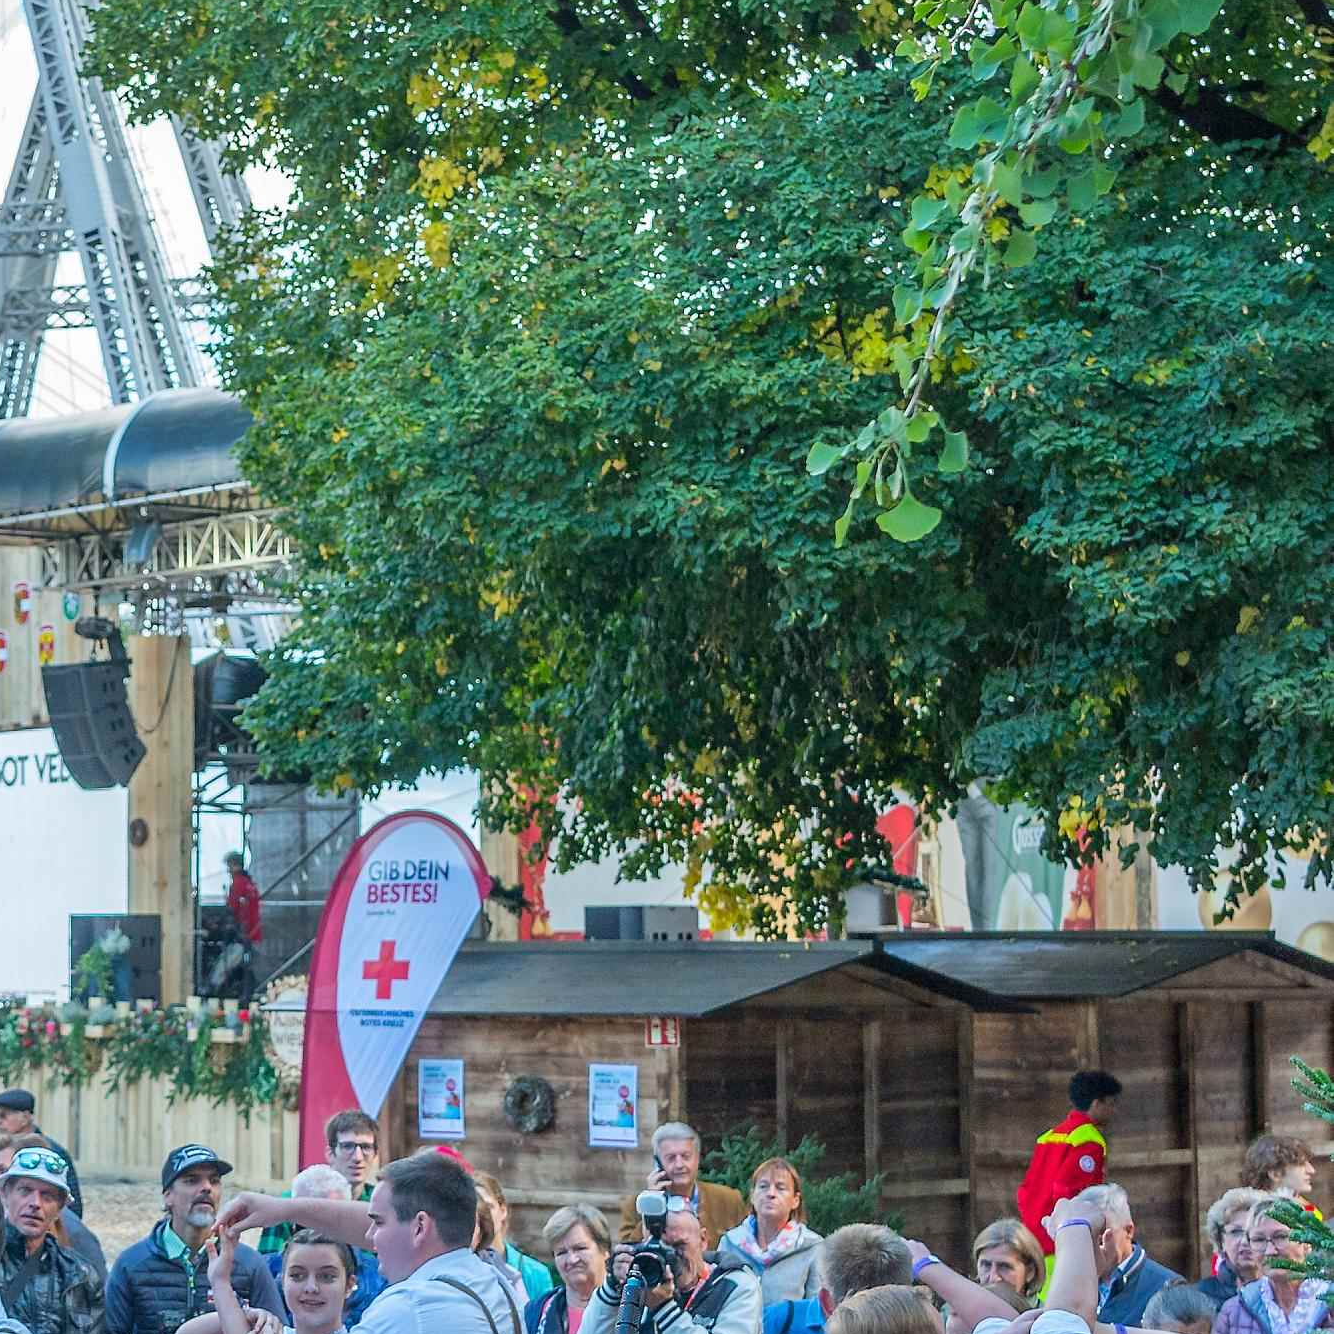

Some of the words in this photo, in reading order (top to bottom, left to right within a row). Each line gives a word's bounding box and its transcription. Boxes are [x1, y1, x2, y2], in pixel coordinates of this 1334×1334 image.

[35, 753, 71, 784] VEL
[369, 860, 400, 882] GIB
[404, 860, 449, 881] DEIN
[367, 883, 438, 904] BESTES!
